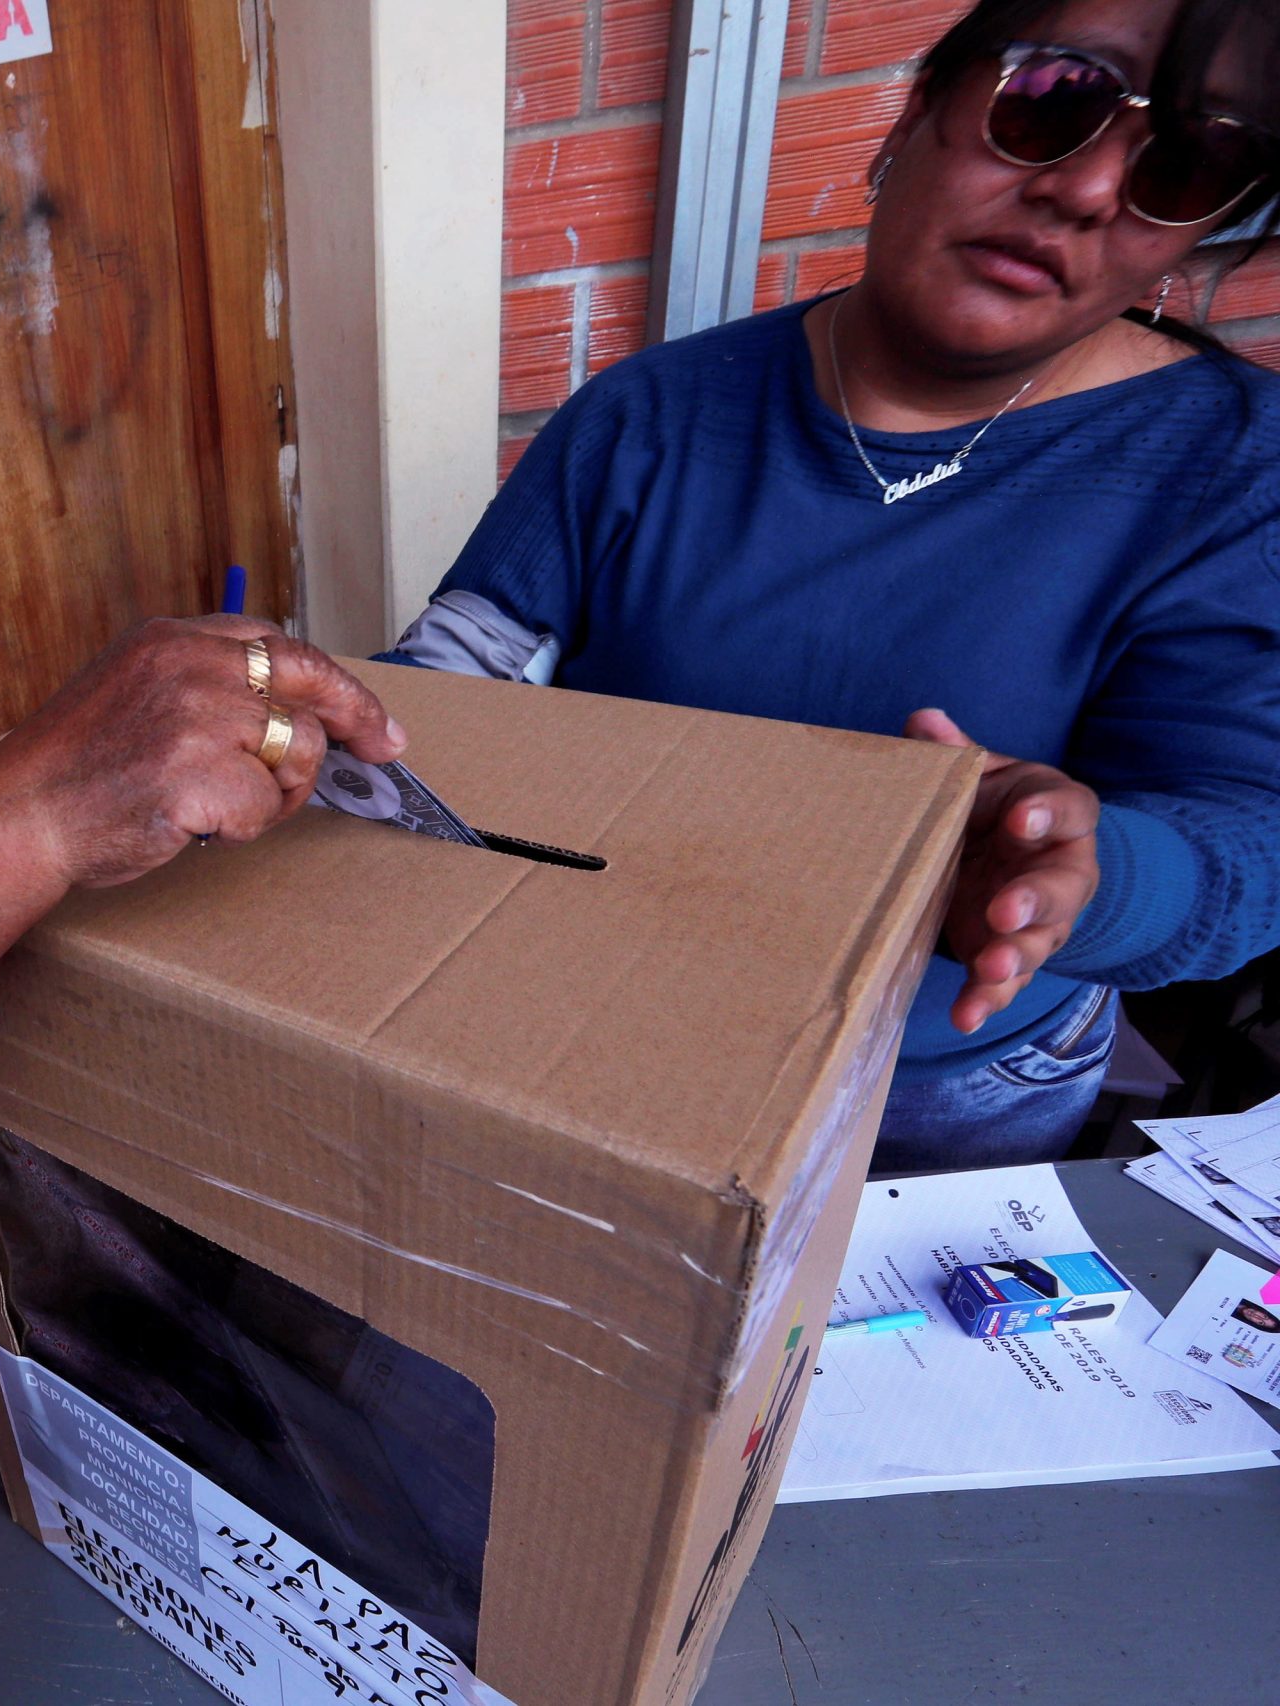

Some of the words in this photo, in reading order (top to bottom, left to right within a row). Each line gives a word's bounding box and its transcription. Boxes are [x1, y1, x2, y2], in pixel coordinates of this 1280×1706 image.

[1008, 1200, 1034, 1232] OEP
[858, 1274, 878, 1302] Recinto:
[877, 1271, 899, 1301] Provincia:
[885, 1255, 918, 1299] Departamento:
[916, 1300, 926, 1309] LA
[943, 1245, 963, 1266] LIST
[983, 1245, 999, 1259] 20
[1054, 1333, 1074, 1349] DE
[1070, 1352, 1101, 1382] 2019
[990, 1227, 1020, 1262] ELECC
[1069, 1328, 1107, 1364] RALES
[1103, 1367, 1135, 1398] 2019
[26, 1373, 185, 1494] DEPARTAMENTO:
[79, 1428, 188, 1515] PROVINCIA:
[87, 1452, 193, 1534] MUNICIPIO:
[81, 1463, 195, 1554] LOCALIDAD:
[107, 1498, 196, 1571] RECINTO:
[58, 1502, 257, 1667] ELECCIONES
[70, 1545, 149, 1617] 2019
[110, 1514, 134, 1540] DE
[140, 1541, 199, 1588] MESA:
[233, 1554, 290, 1602] EL
[65, 1525, 245, 1676] GENERALES
[324, 1671, 347, 1697] 9
